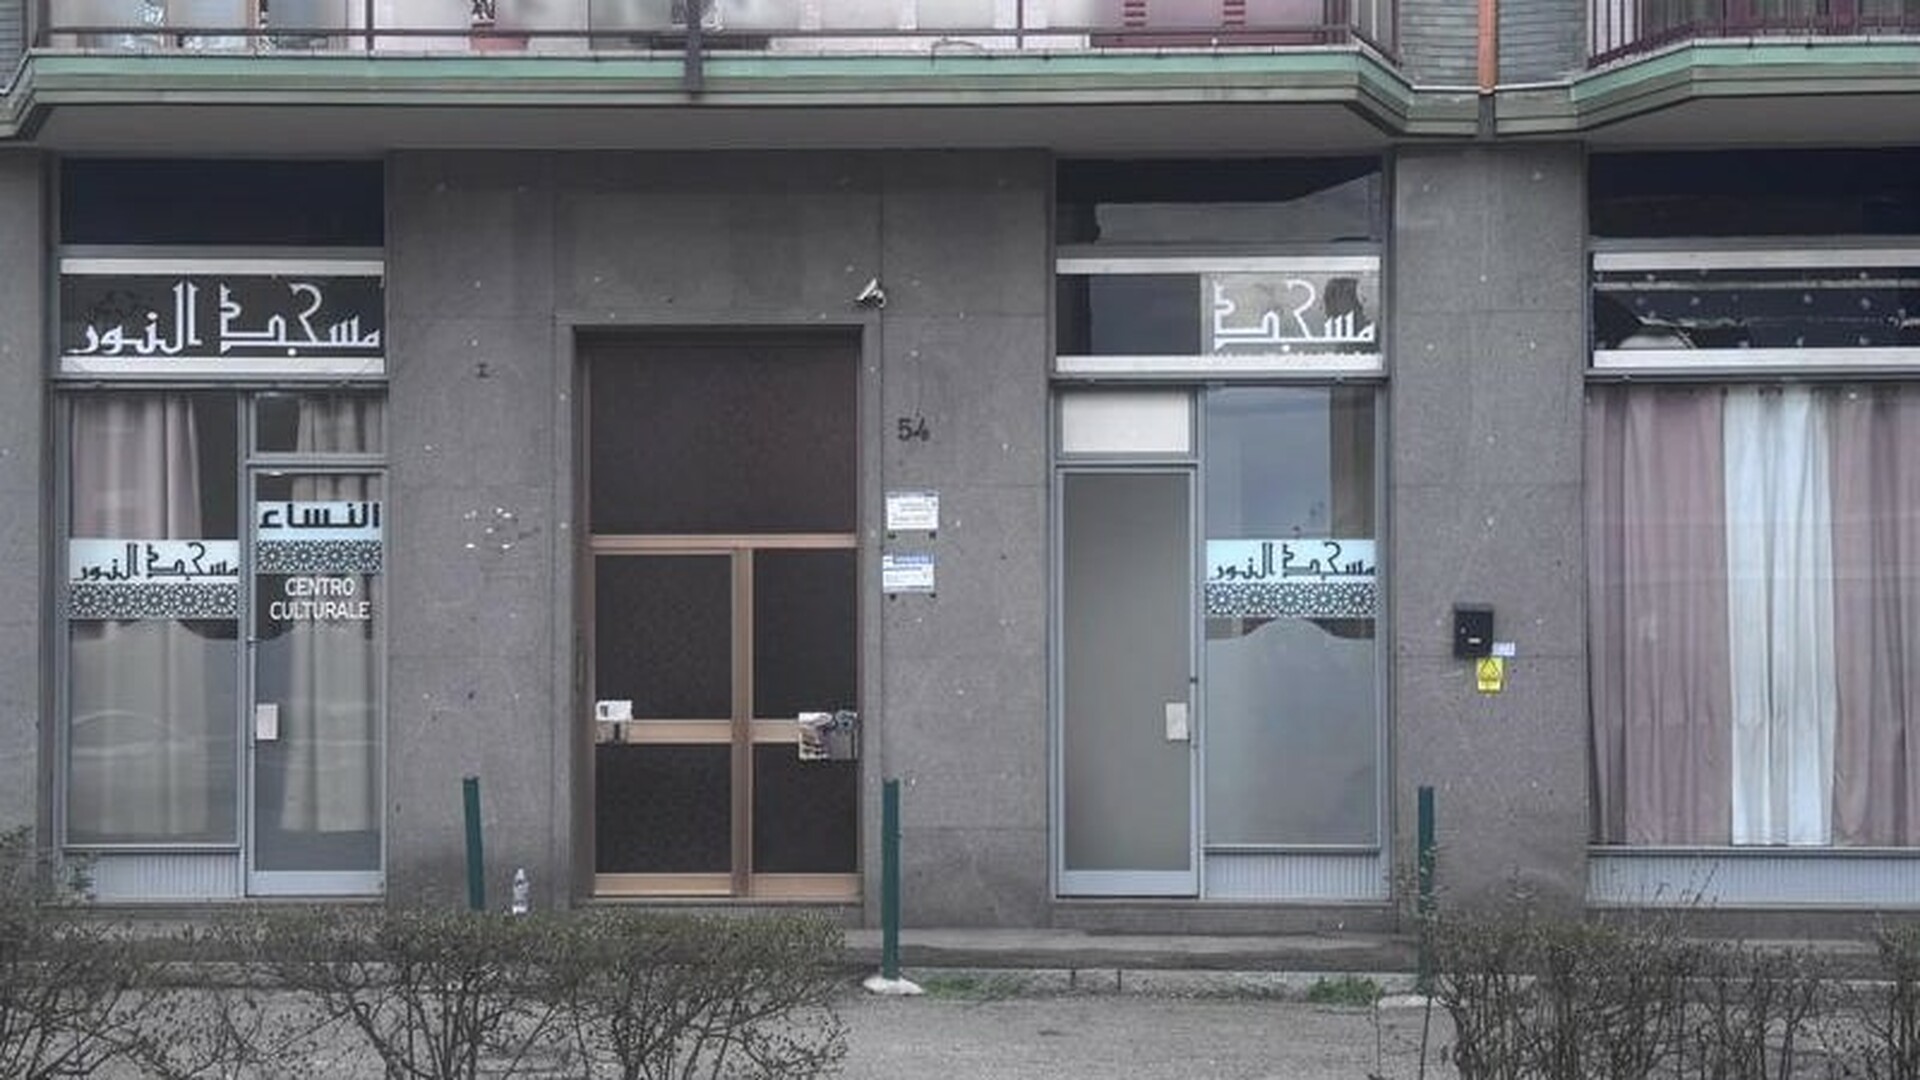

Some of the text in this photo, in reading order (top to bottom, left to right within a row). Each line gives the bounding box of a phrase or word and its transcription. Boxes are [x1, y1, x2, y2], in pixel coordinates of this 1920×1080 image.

[66, 282, 381, 357] مسجد النور
[1214, 279, 1376, 353] مسجد
[898, 417, 930, 441] 54
[258, 502, 380, 530] النساء
[74, 543, 139, 582] النور
[1209, 542, 1276, 582] النور
[285, 577, 355, 597] CENTRO
[269, 601, 371, 620] CULTURALE
